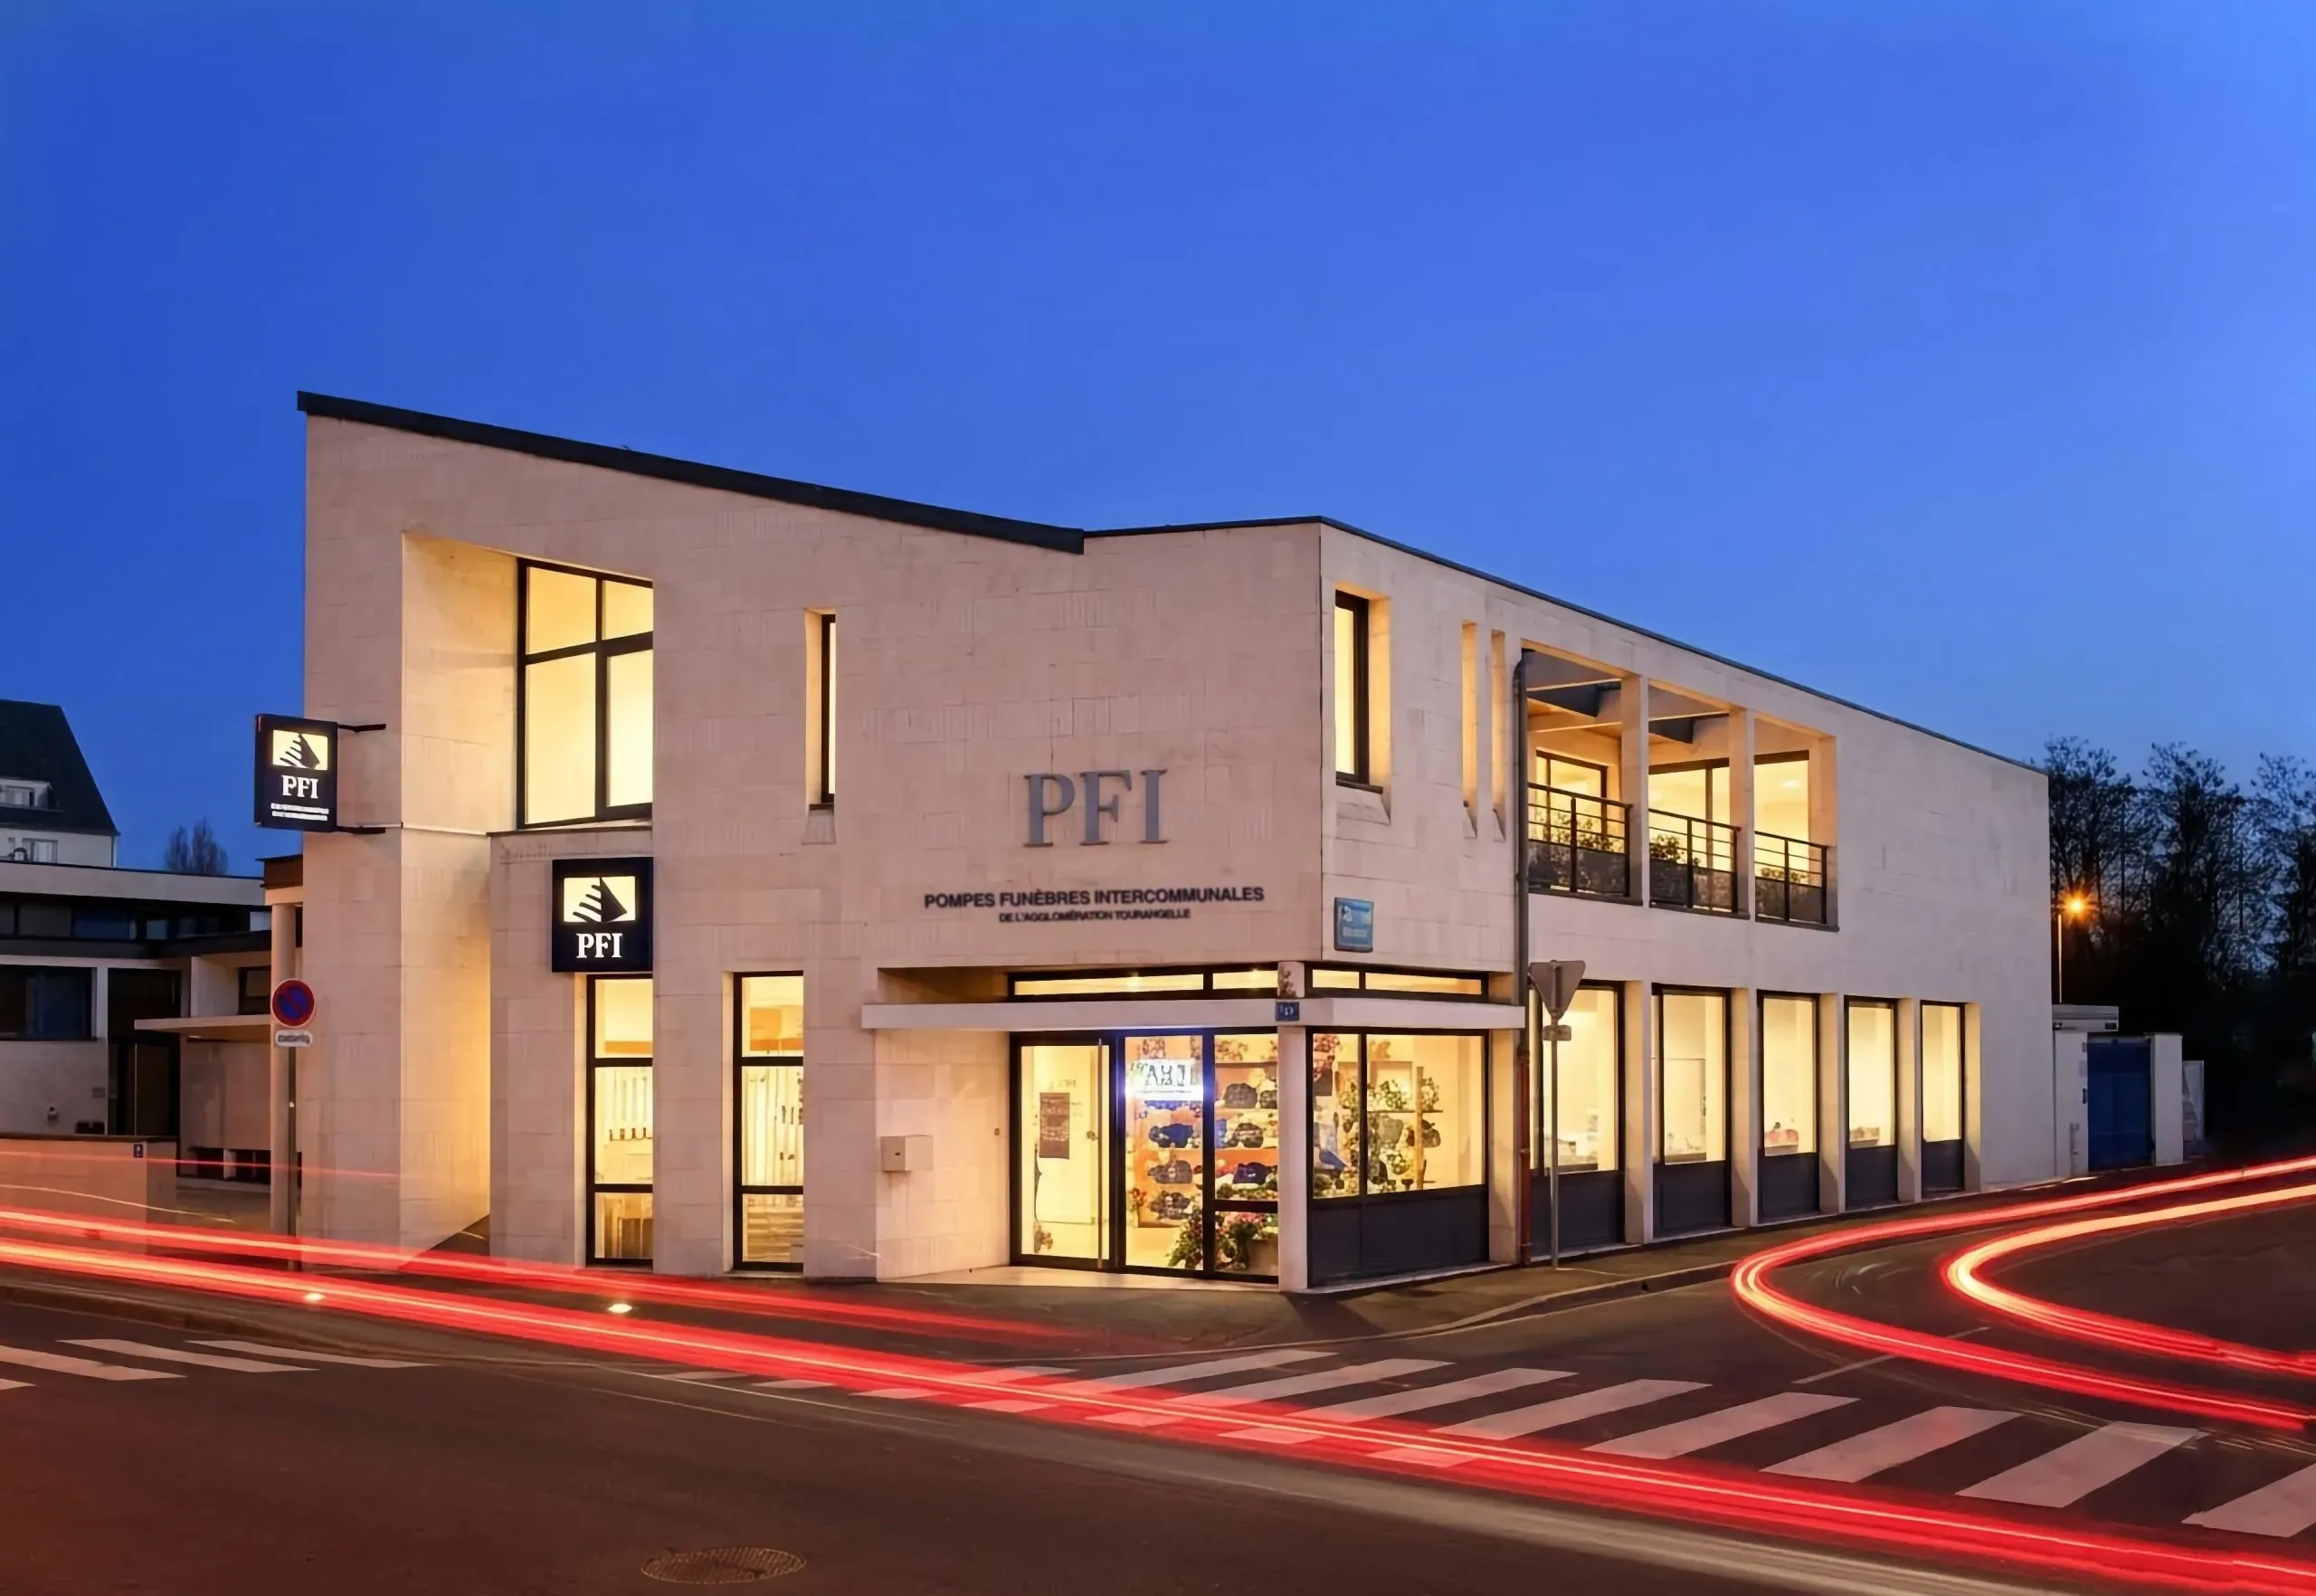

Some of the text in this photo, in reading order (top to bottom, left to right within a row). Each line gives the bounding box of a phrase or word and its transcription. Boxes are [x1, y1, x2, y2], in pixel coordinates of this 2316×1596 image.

[281, 774, 319, 799] PFI
[1023, 769, 1169, 848] PFI
[925, 887, 1265, 908] POMPES FUNÈBRES INTERCOMMUNALES
[999, 908, 1191, 923] DE L'AGGLOMÉRATION TOURANGELLE
[575, 933, 623, 958] PFI
